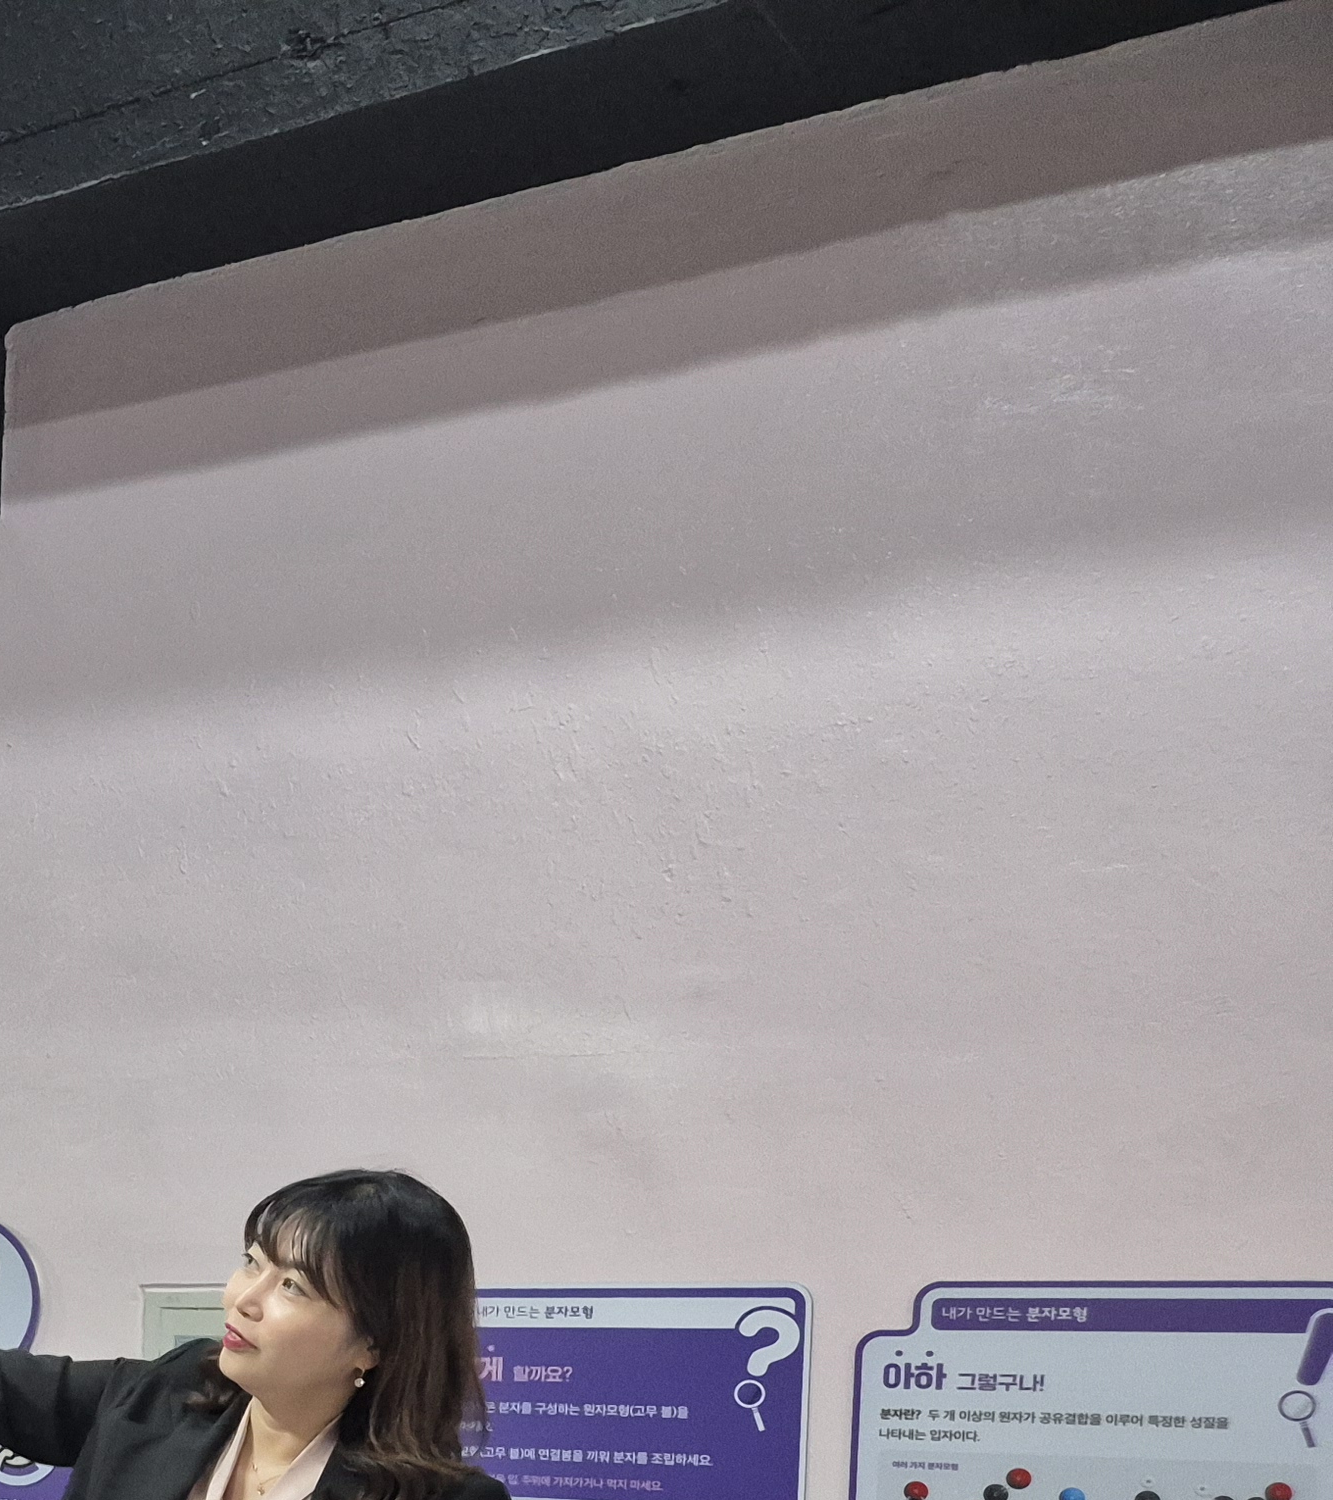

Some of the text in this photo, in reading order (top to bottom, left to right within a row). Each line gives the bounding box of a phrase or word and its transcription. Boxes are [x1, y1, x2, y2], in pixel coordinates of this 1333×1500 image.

[503, 1305, 541, 1319] 만드는
[544, 1305, 594, 1320] 분자모형
[941, 1306, 1088, 1323] 내가 만드는 분자모형
[882, 1360, 1045, 1393] 아하 그렇구나!
[880, 1408, 1229, 1430] 분자란? 두 개 이상의 원자가 공유결합을 이루어 특정한 성질을
[878, 1428, 981, 1442] 나타내는 입자이다.
